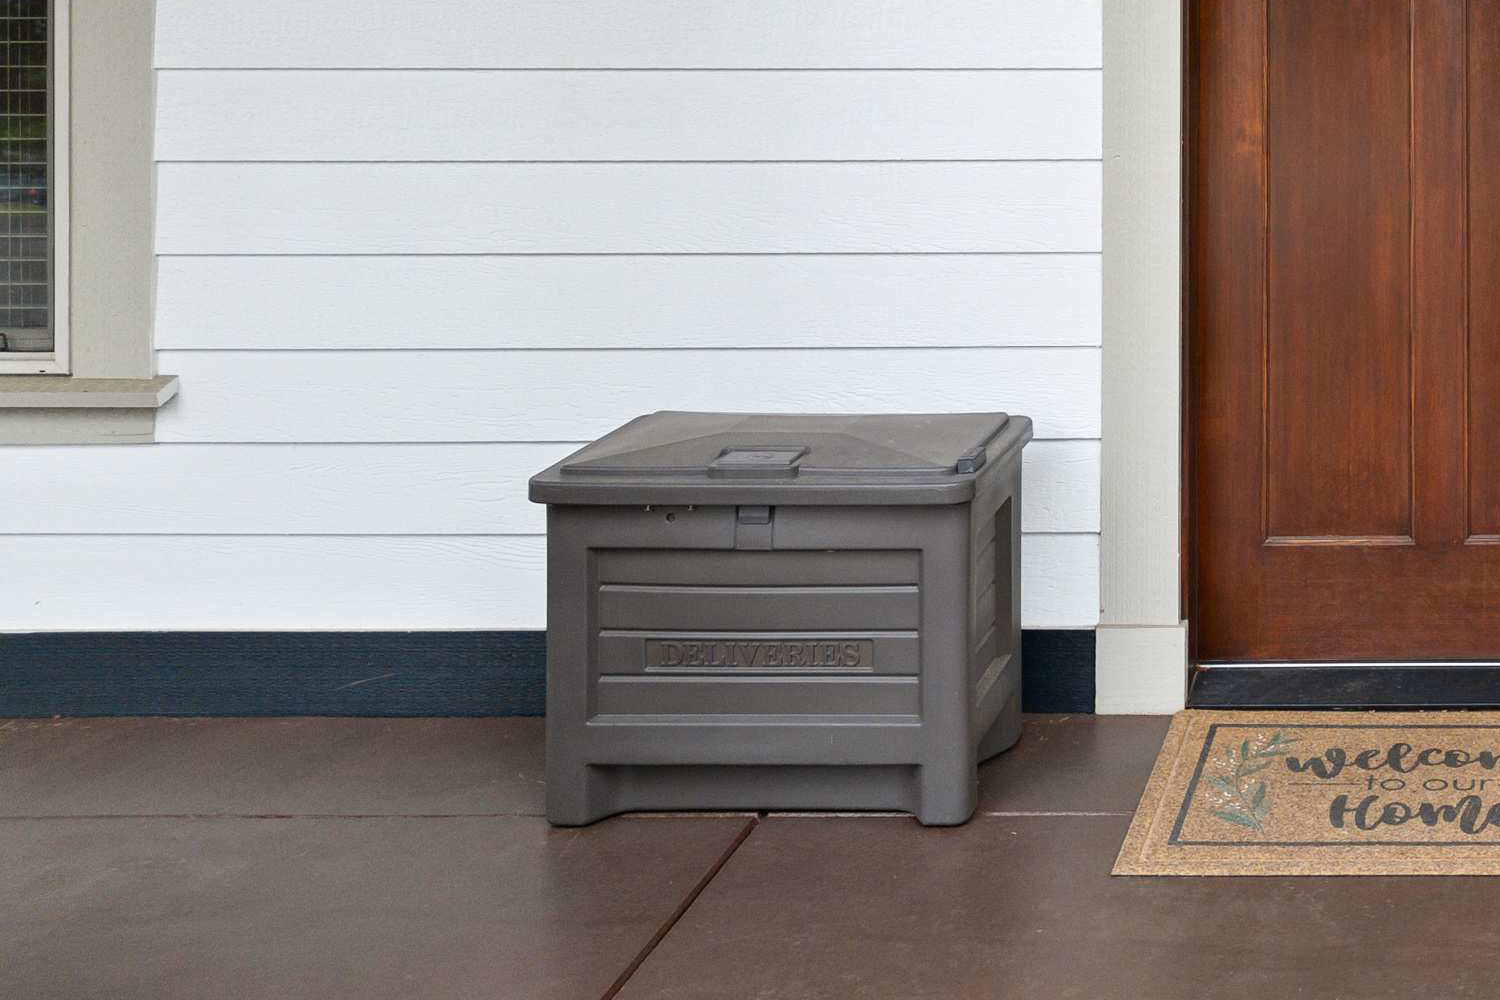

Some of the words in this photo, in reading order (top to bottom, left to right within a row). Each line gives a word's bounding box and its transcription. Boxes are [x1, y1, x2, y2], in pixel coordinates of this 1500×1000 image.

[660, 641, 862, 668] DELIVERIES
[1364, 774, 1406, 791] to
[1422, 777, 1493, 791] our
